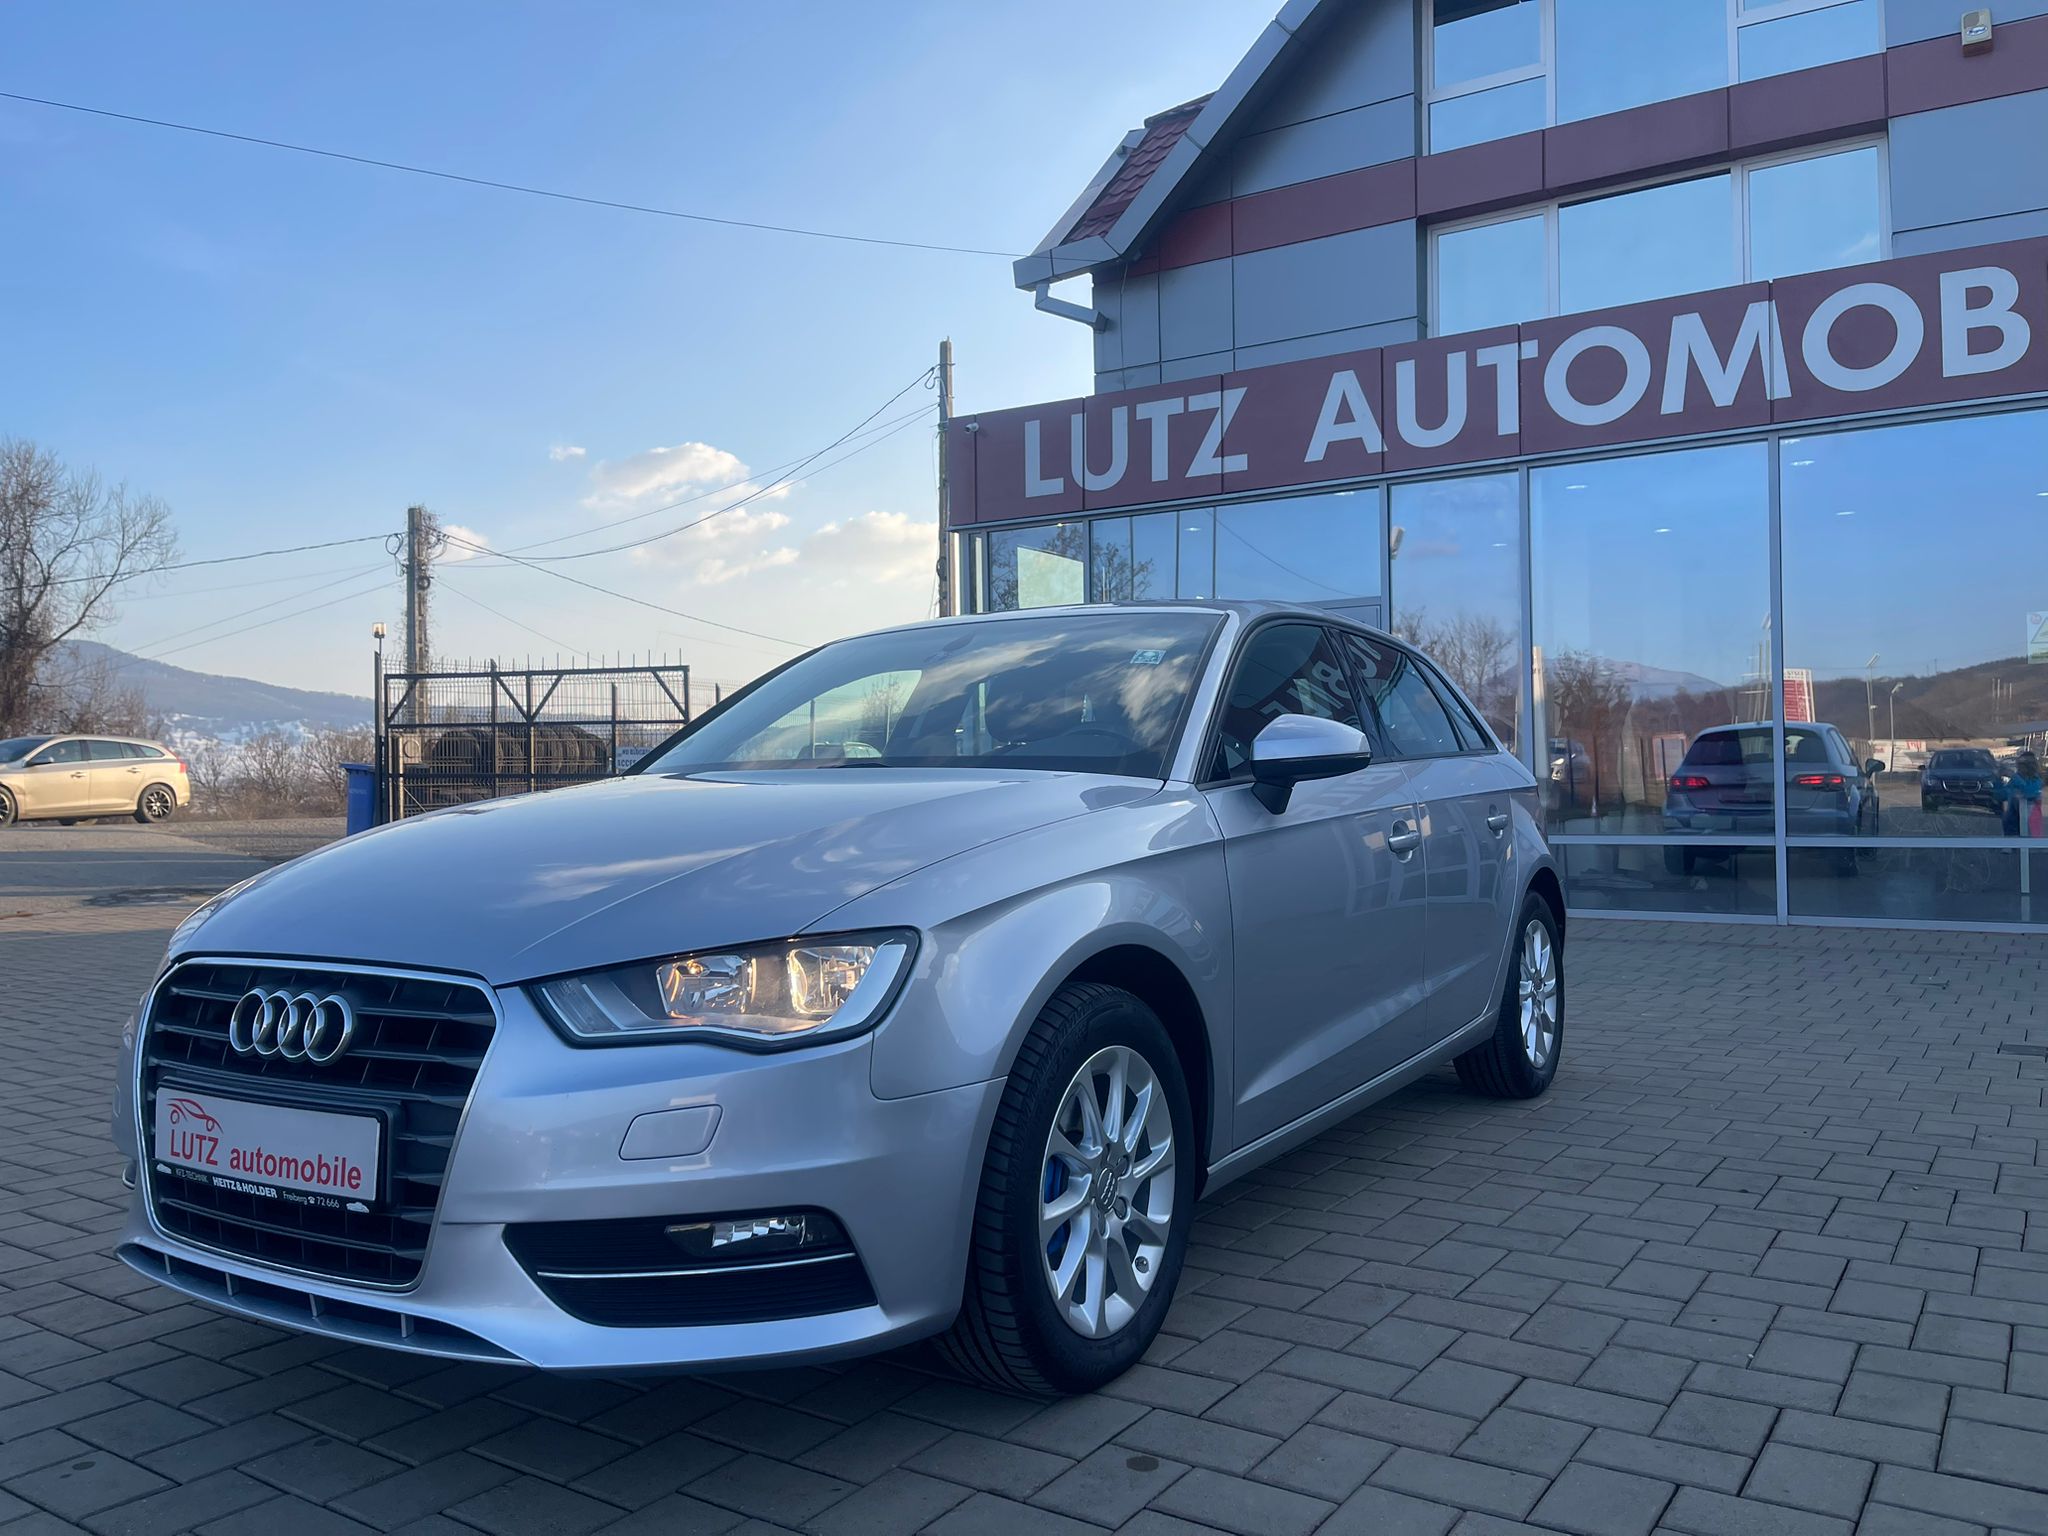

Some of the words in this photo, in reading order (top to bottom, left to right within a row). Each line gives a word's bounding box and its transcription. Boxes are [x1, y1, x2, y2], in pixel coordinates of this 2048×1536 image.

[1024, 388, 1248, 498] LUTZ
[1304, 267, 2030, 463] AUTOMOB
[170, 1129, 218, 1166] LUTZ
[229, 1147, 362, 1190] automobile
[213, 1177, 278, 1199] HEITZ&HOLDER
